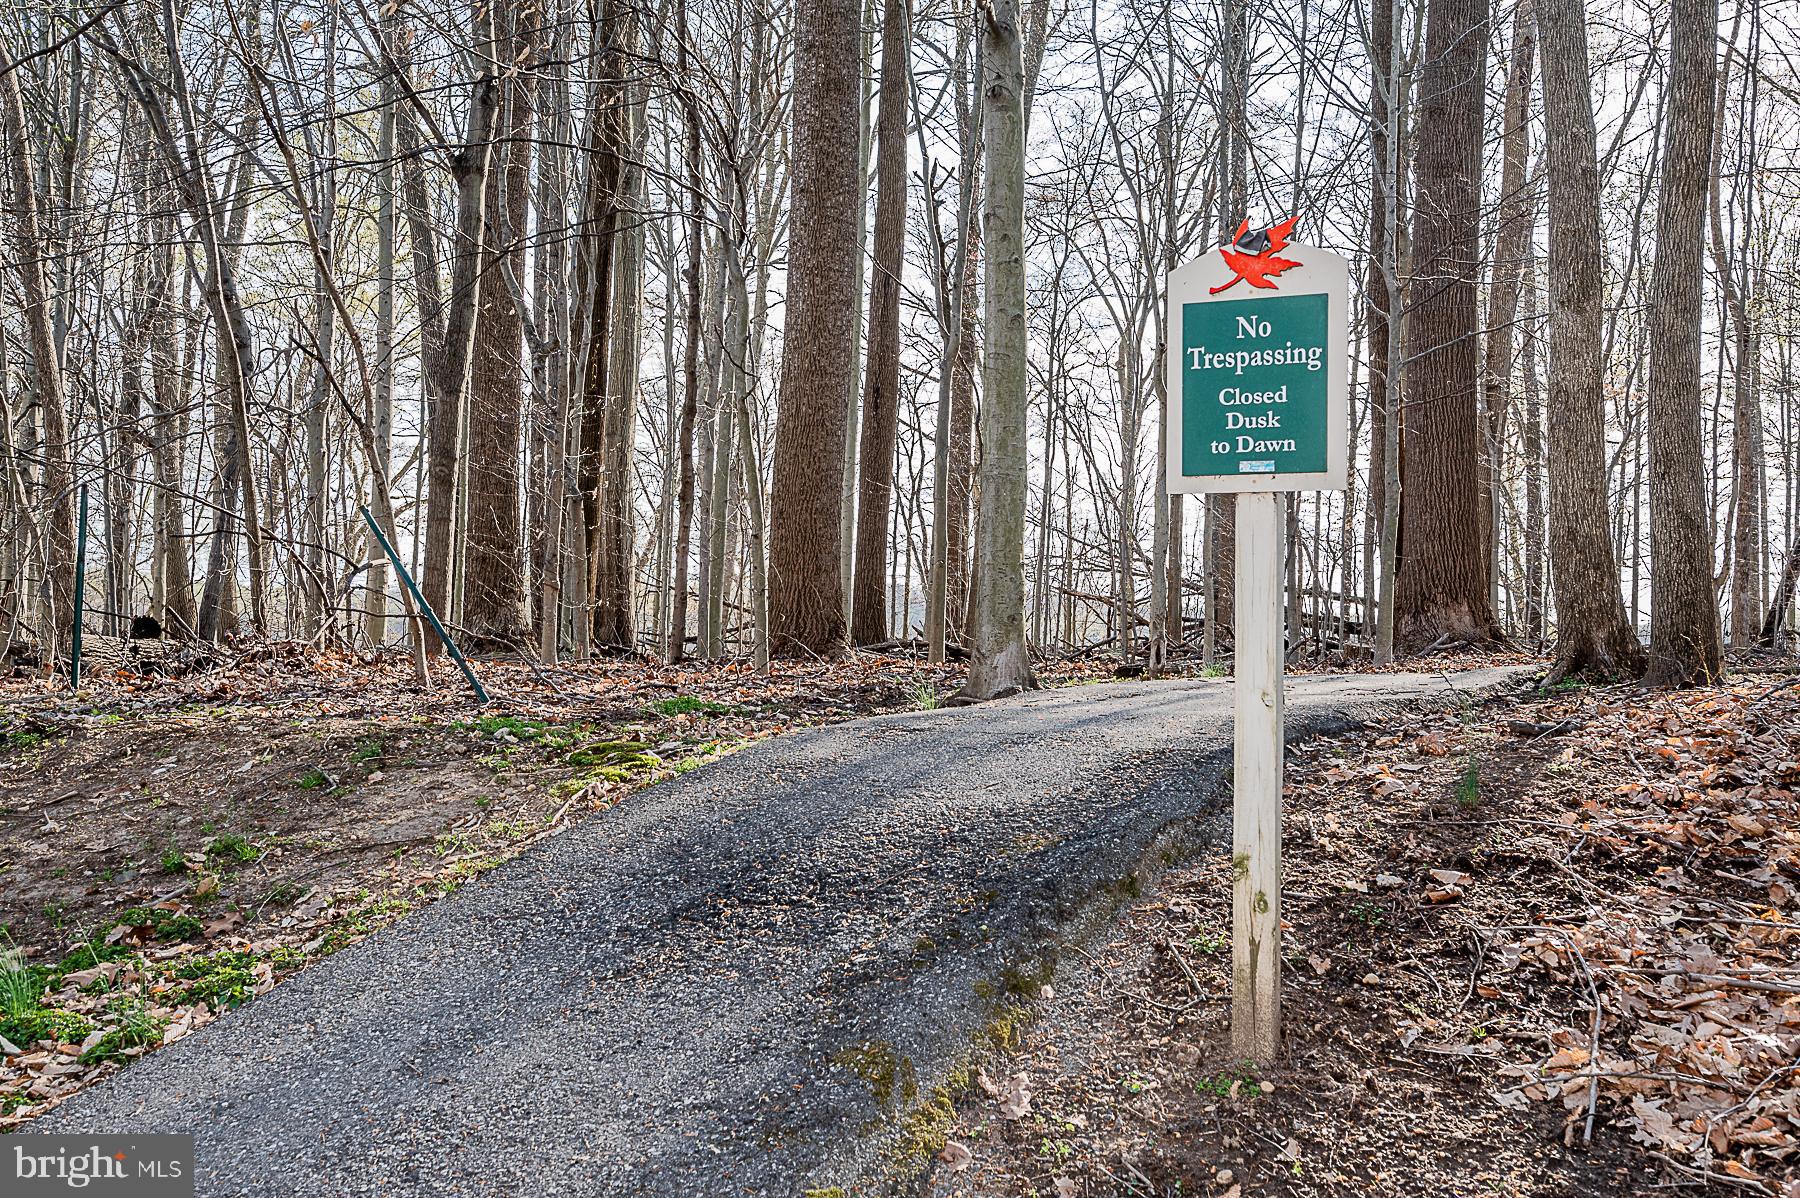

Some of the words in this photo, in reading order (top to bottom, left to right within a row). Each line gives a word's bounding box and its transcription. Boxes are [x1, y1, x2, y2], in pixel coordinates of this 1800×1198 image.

[1236, 315, 1272, 339] No
[1187, 341, 1323, 375] Trespassing
[1218, 385, 1288, 406] Closed
[1225, 410, 1281, 430] Dusk
[1210, 440, 1231, 454] to
[1235, 436, 1297, 453] Dawn
